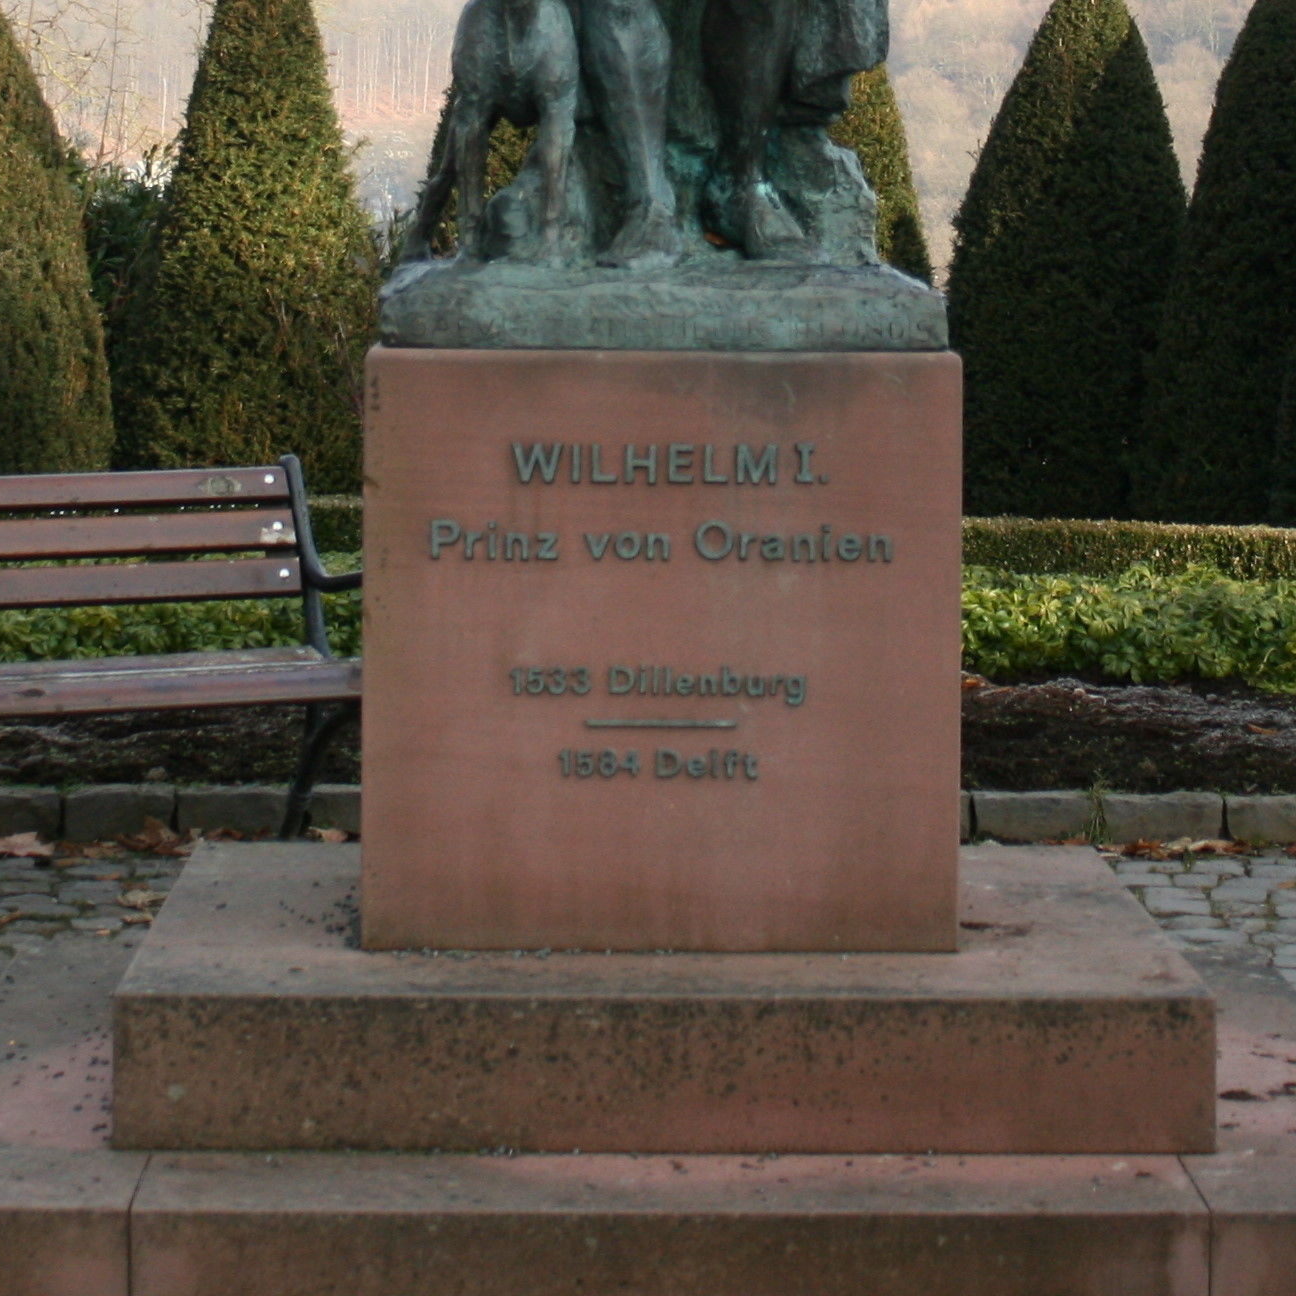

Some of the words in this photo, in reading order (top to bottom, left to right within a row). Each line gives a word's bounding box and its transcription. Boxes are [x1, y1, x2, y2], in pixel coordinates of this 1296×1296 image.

[512, 441, 777, 484] WILHELM
[794, 441, 830, 484] I.
[429, 519, 559, 561] Prinz
[585, 529, 672, 562] von
[694, 519, 895, 563] Oranien
[509, 666, 591, 696] 1533
[607, 665, 807, 704] Dillenburg
[558, 748, 640, 778] 1584
[655, 748, 760, 780] Delft
